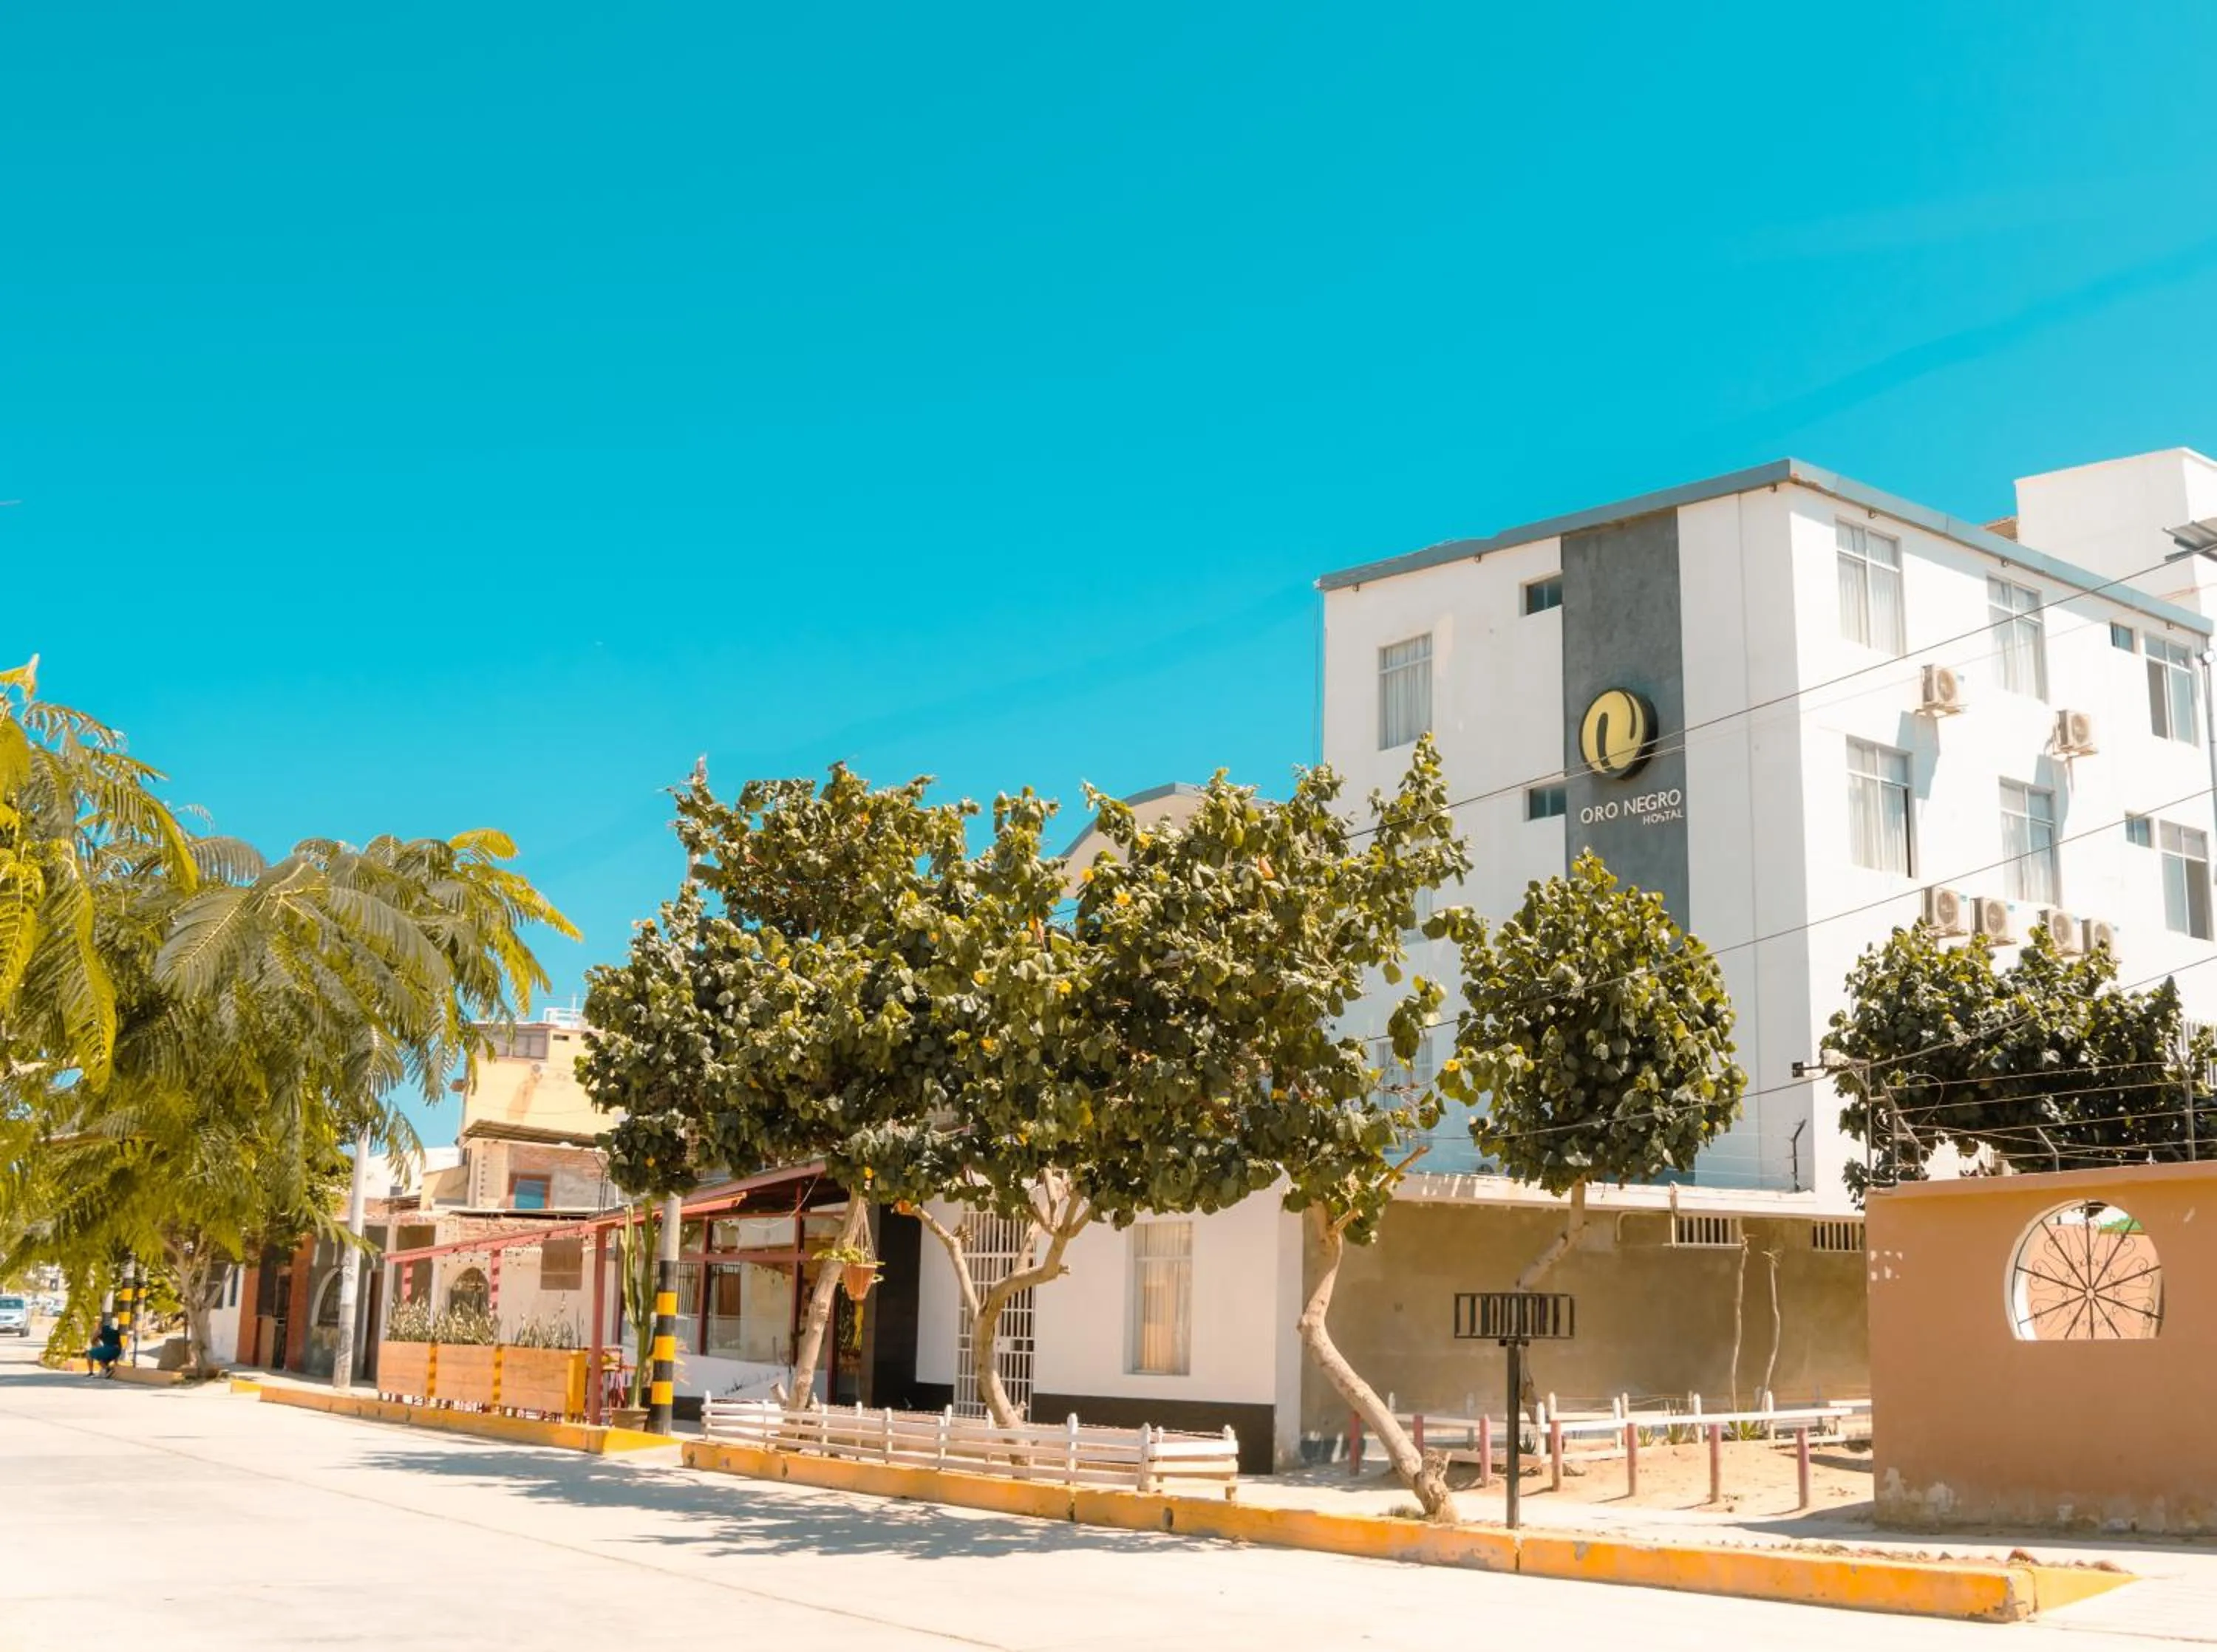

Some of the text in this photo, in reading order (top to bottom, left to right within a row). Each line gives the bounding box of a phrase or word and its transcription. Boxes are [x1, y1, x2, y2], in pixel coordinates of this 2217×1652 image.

[1581, 788, 1681, 824] ORO NEGRO
[1643, 808, 1683, 825] HOSTAL
